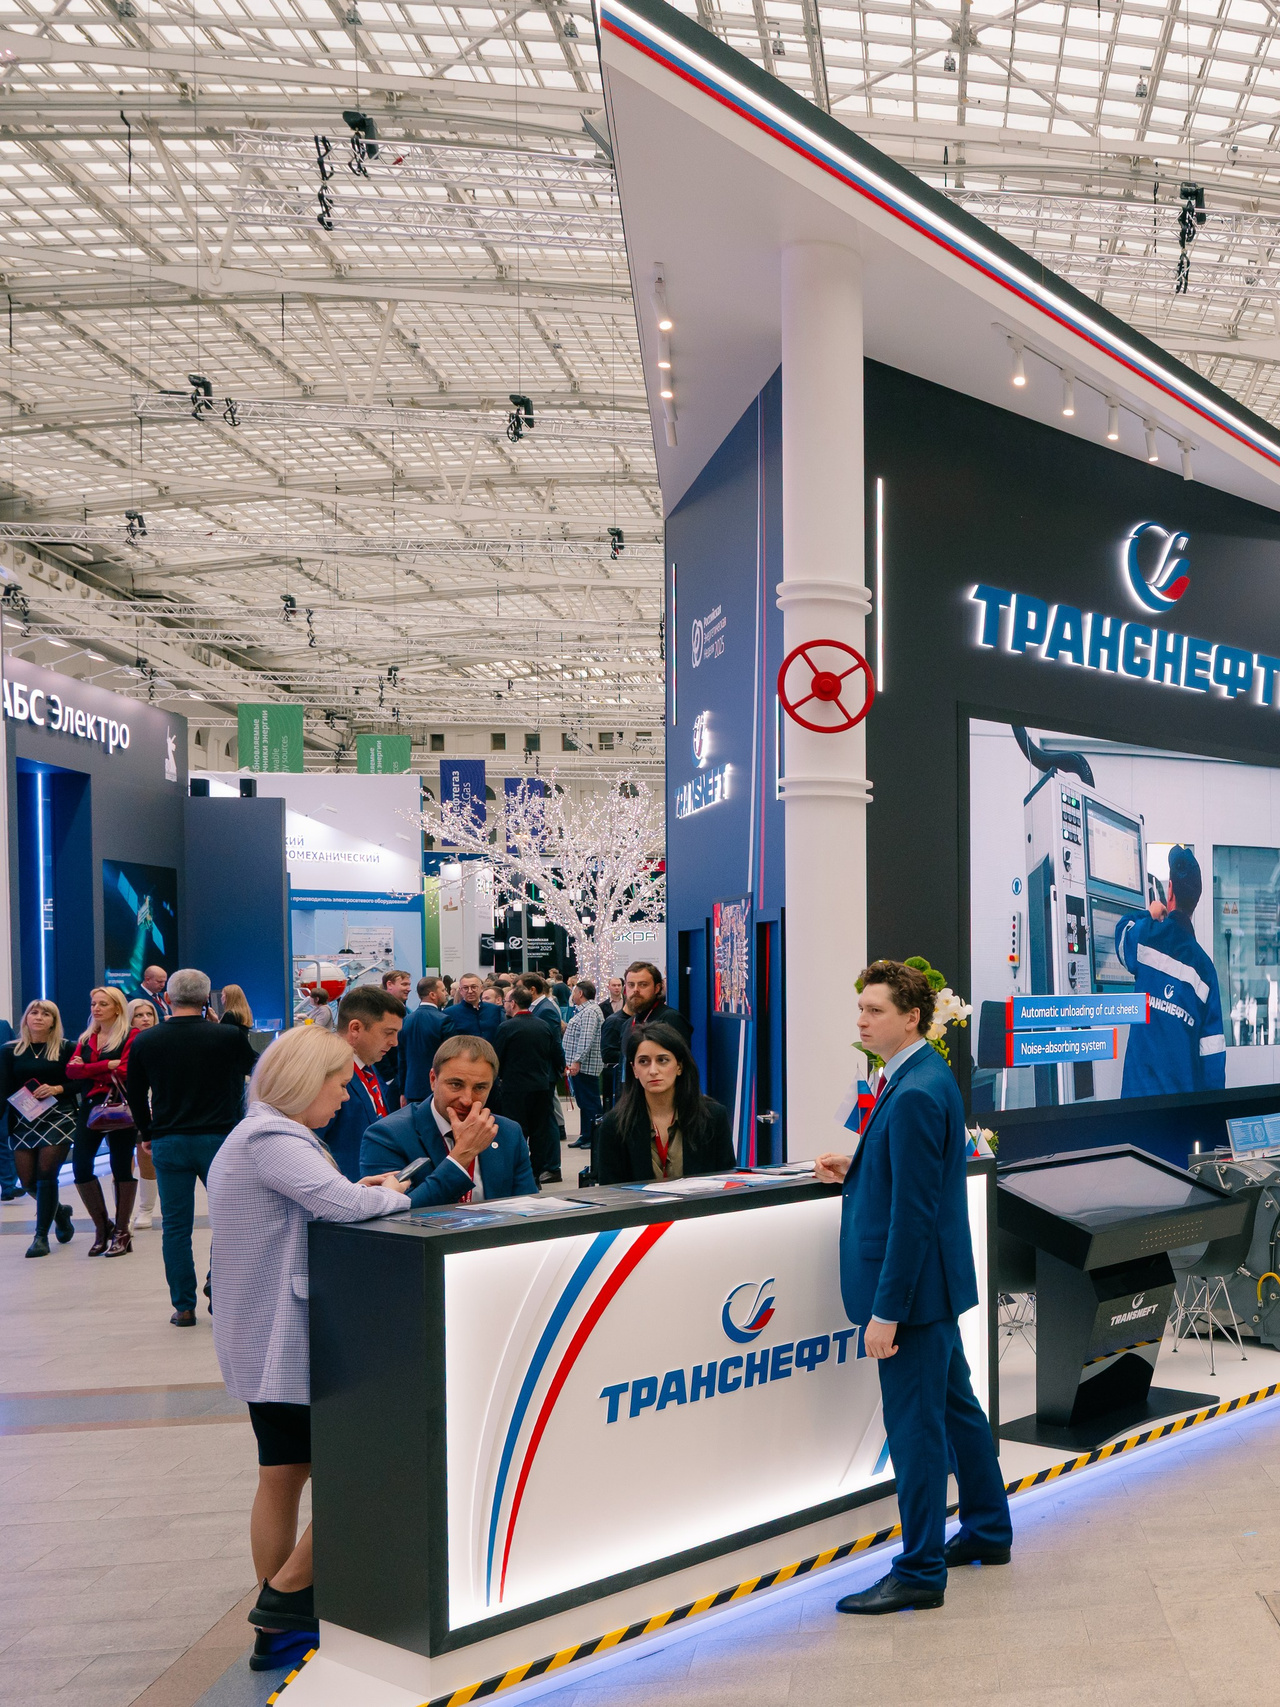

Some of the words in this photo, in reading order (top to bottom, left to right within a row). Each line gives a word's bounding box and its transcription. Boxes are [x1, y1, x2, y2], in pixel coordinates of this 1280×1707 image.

[50, 694, 130, 754] Электро
[1021, 1005, 1059, 1018] Automatic
[1060, 1004, 1095, 1019] unloading
[1096, 1004, 1103, 1016] of
[1104, 1005, 1115, 1016] cut
[1117, 1004, 1138, 1015] sheets
[1021, 1040, 1080, 1055] Noise-absorbing
[1081, 1039, 1106, 1053] system
[1111, 1304, 1158, 1326] TRANSNEFT
